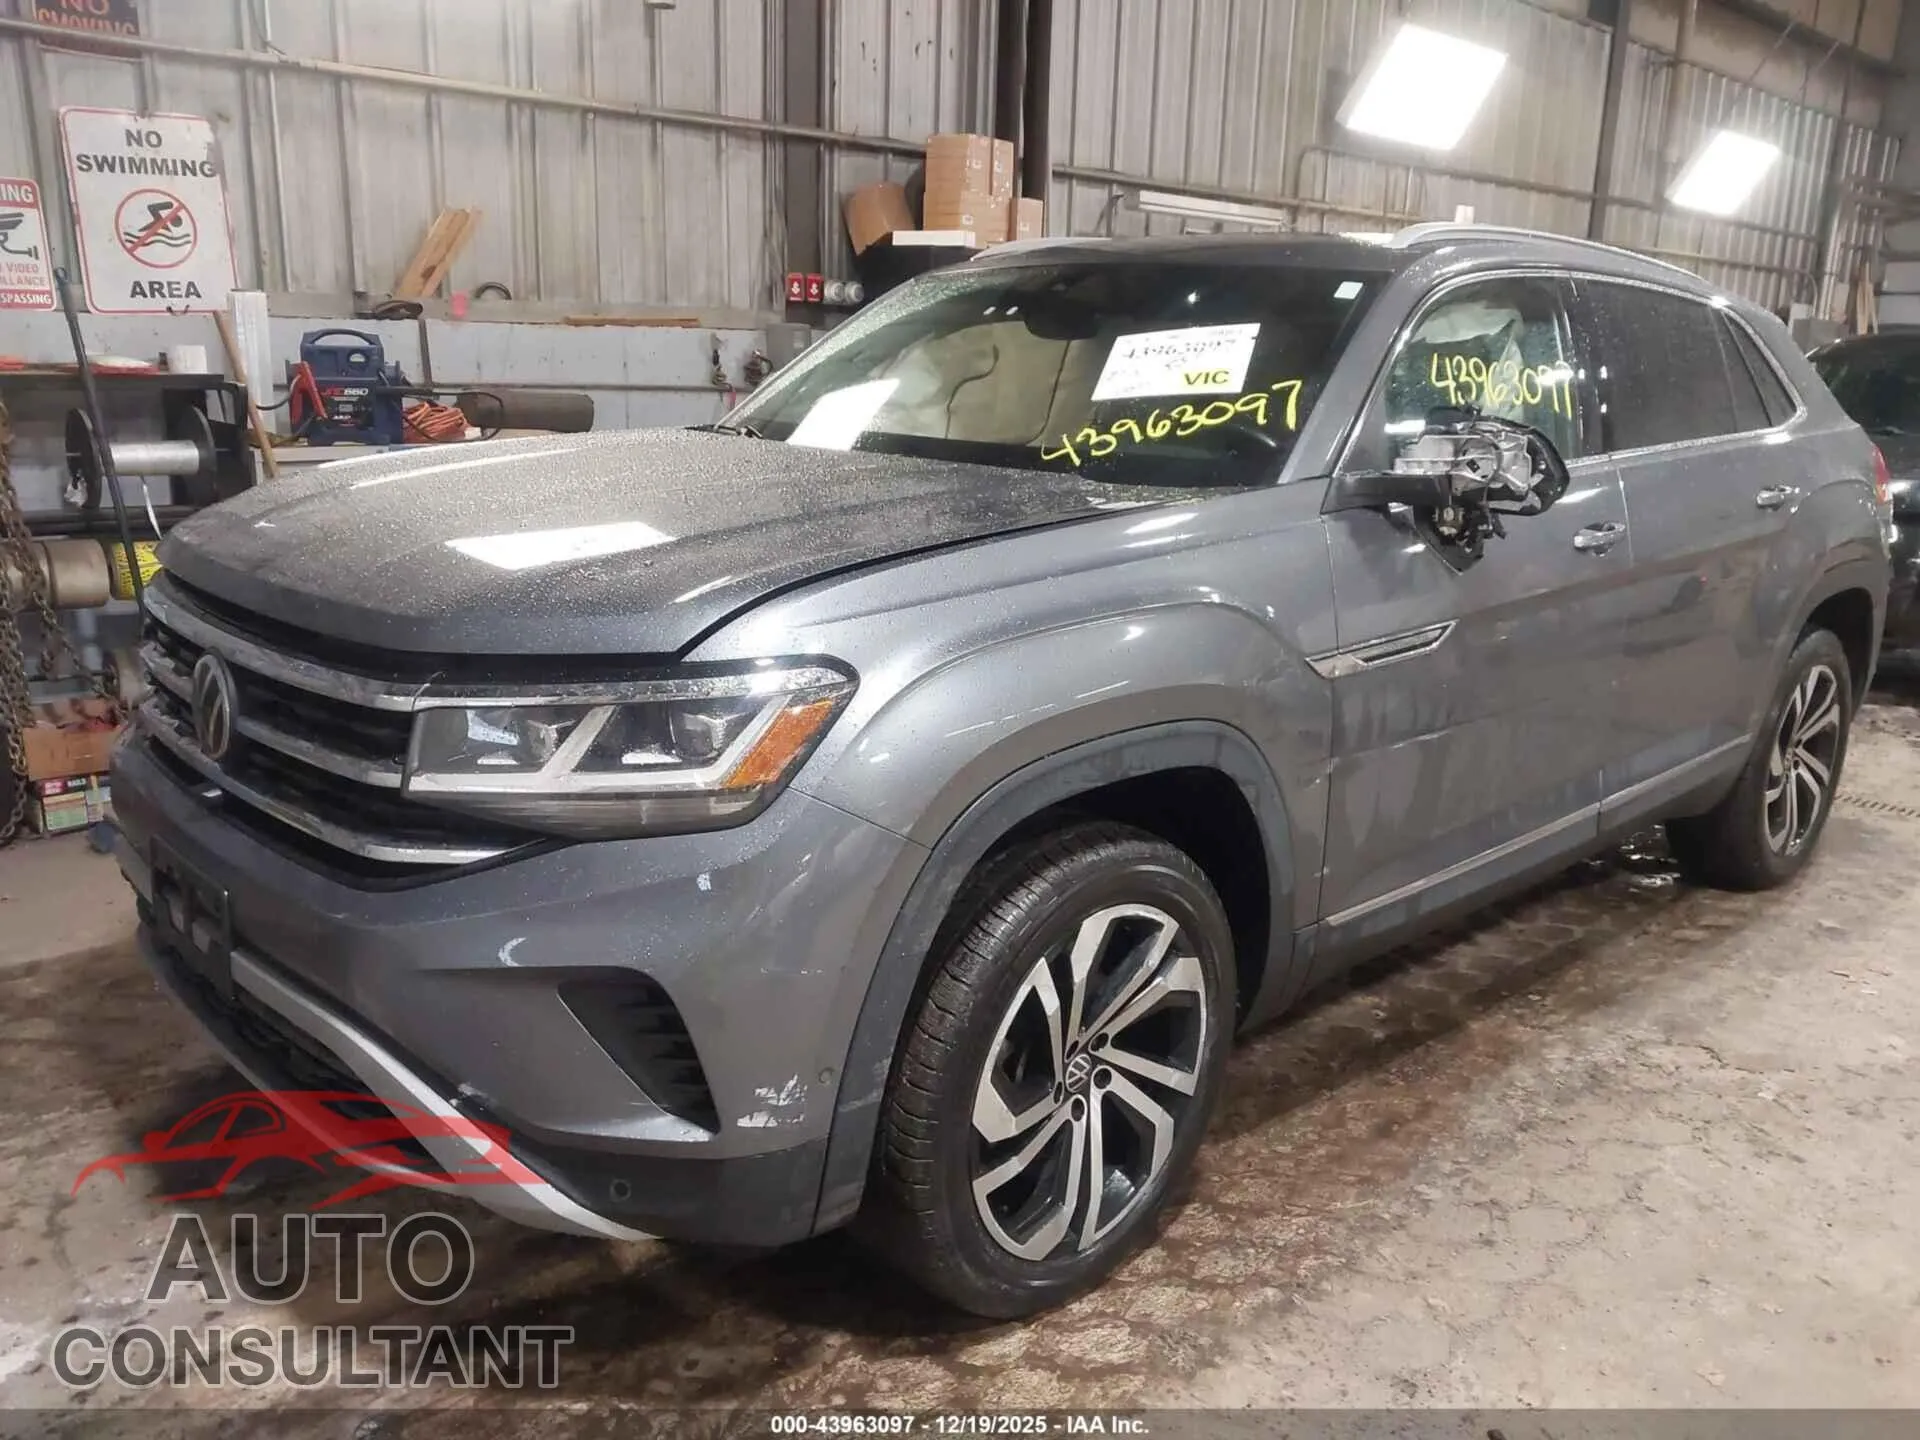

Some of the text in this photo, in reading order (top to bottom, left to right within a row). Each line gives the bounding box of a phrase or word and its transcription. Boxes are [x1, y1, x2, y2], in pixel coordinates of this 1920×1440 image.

[125, 129, 163, 148] NO
[76, 154, 217, 178] SWIMMING
[6, 262, 39, 275] VIDEO
[130, 281, 202, 298] AREA
[1183, 369, 1230, 386] VIC
[1041, 379, 1303, 467] 43963097
